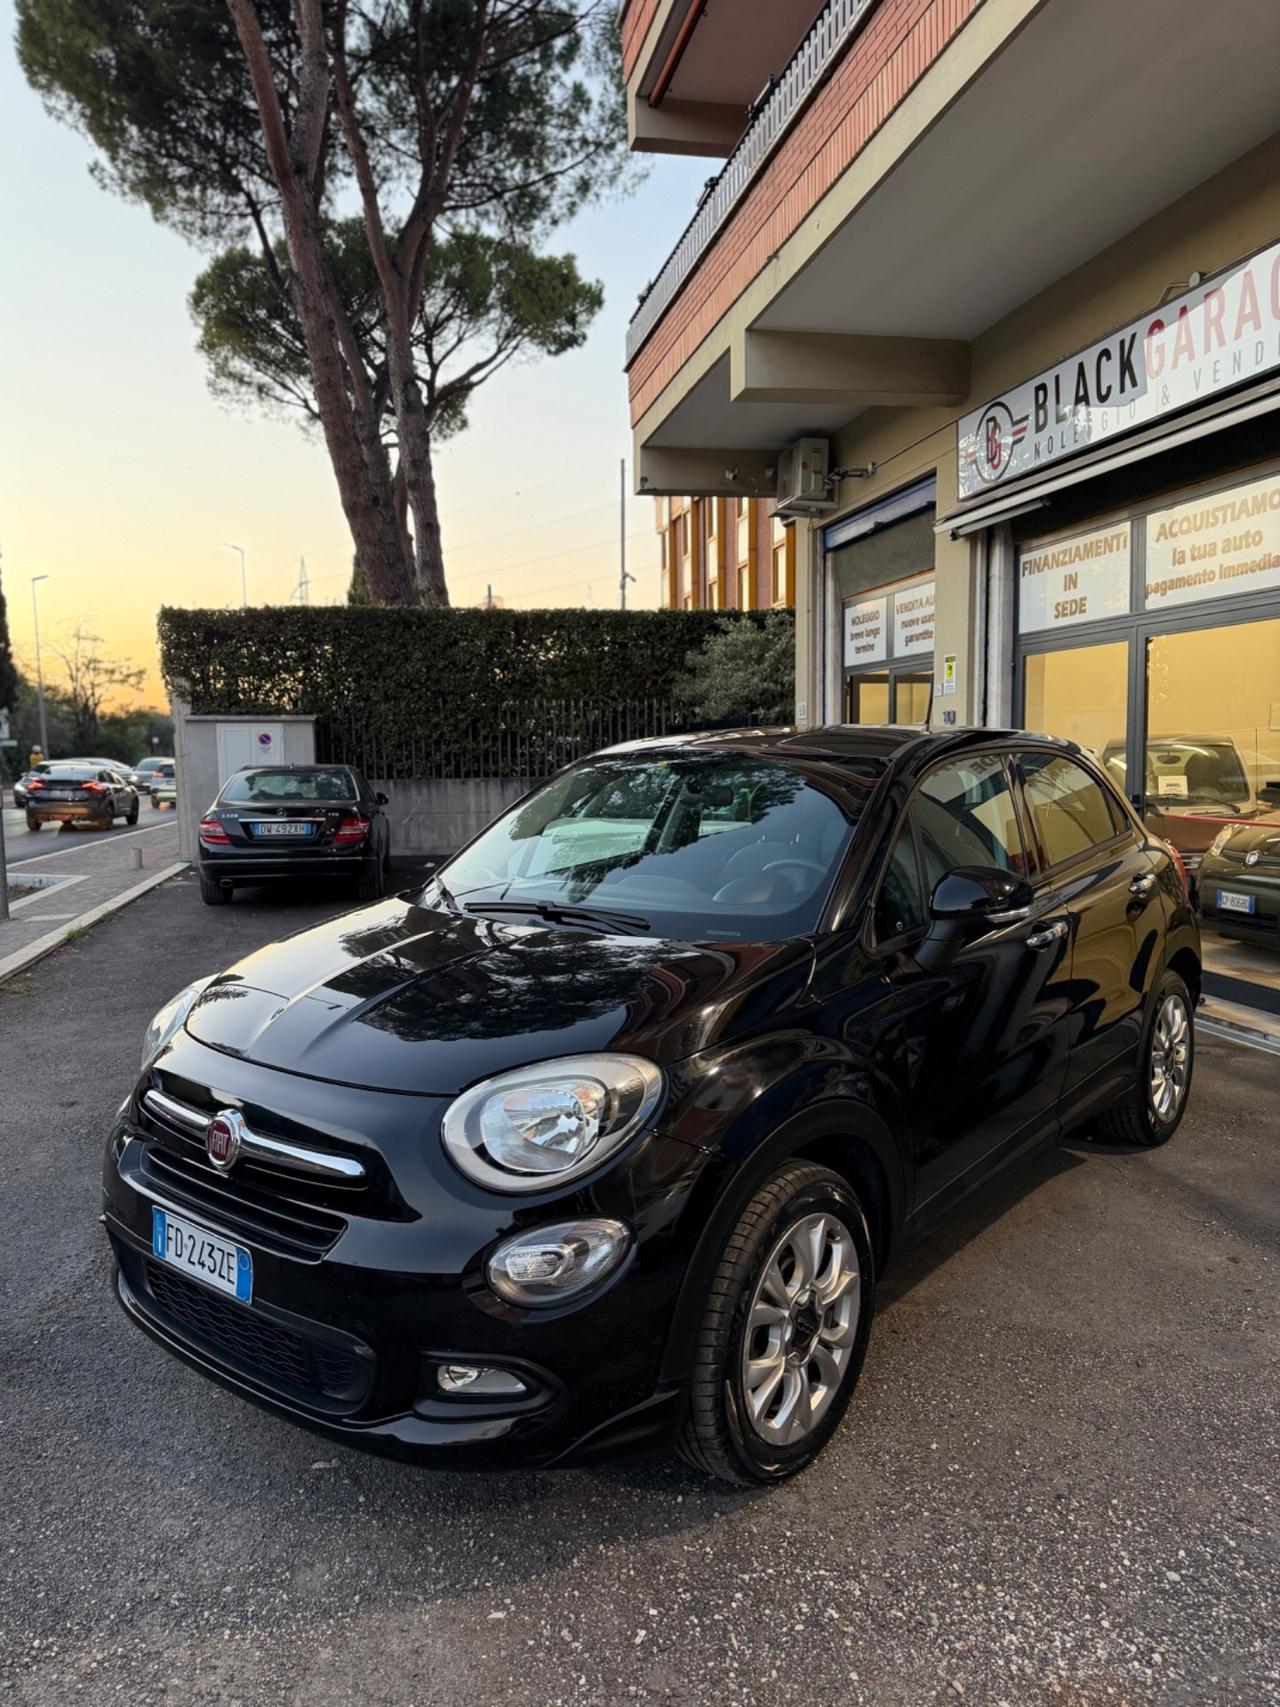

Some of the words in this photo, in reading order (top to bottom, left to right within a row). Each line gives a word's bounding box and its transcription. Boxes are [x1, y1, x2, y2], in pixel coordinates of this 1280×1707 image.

[1034, 398, 1136, 460] NOLEGIO
[1193, 332, 1280, 391] VEND
[1155, 488, 1280, 543] ACQUISTIAMO
[1022, 531, 1128, 577] FINANZIAMENTI
[1172, 547, 1186, 567] la
[1190, 541, 1217, 562] tua
[1221, 530, 1264, 554] auto
[1063, 572, 1079, 592] IN
[1145, 568, 1216, 600] pagamento
[851, 610, 880, 627] NOLEGGIO
[1054, 596, 1088, 620] SEDE
[208, 1129, 229, 1155] FIAT
